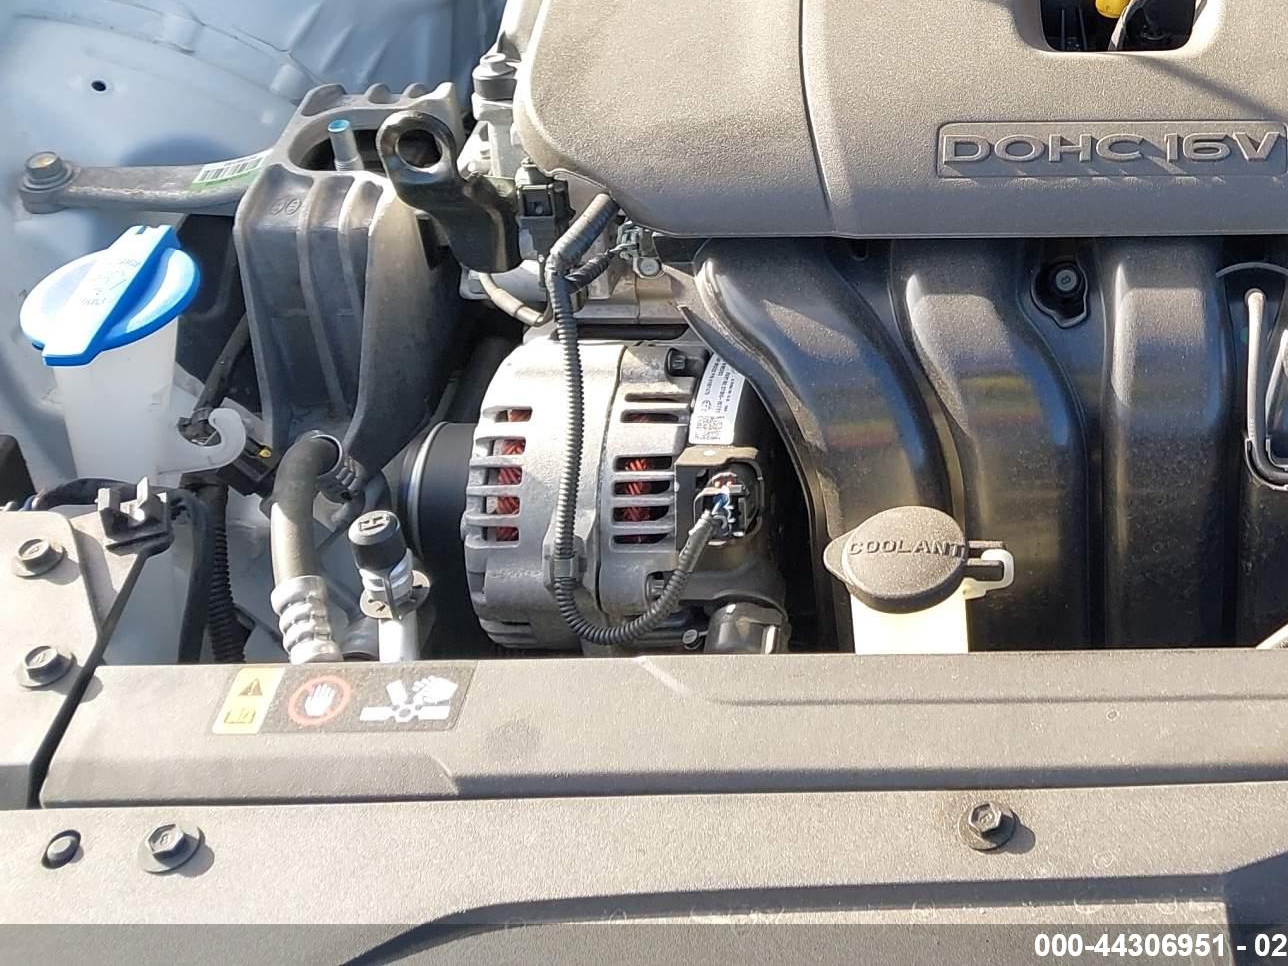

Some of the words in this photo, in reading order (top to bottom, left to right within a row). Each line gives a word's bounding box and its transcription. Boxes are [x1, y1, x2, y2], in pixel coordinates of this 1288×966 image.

[942, 133, 1144, 164] DOHC
[1164, 131, 1283, 163] 16V
[848, 540, 964, 558] COOLANT
